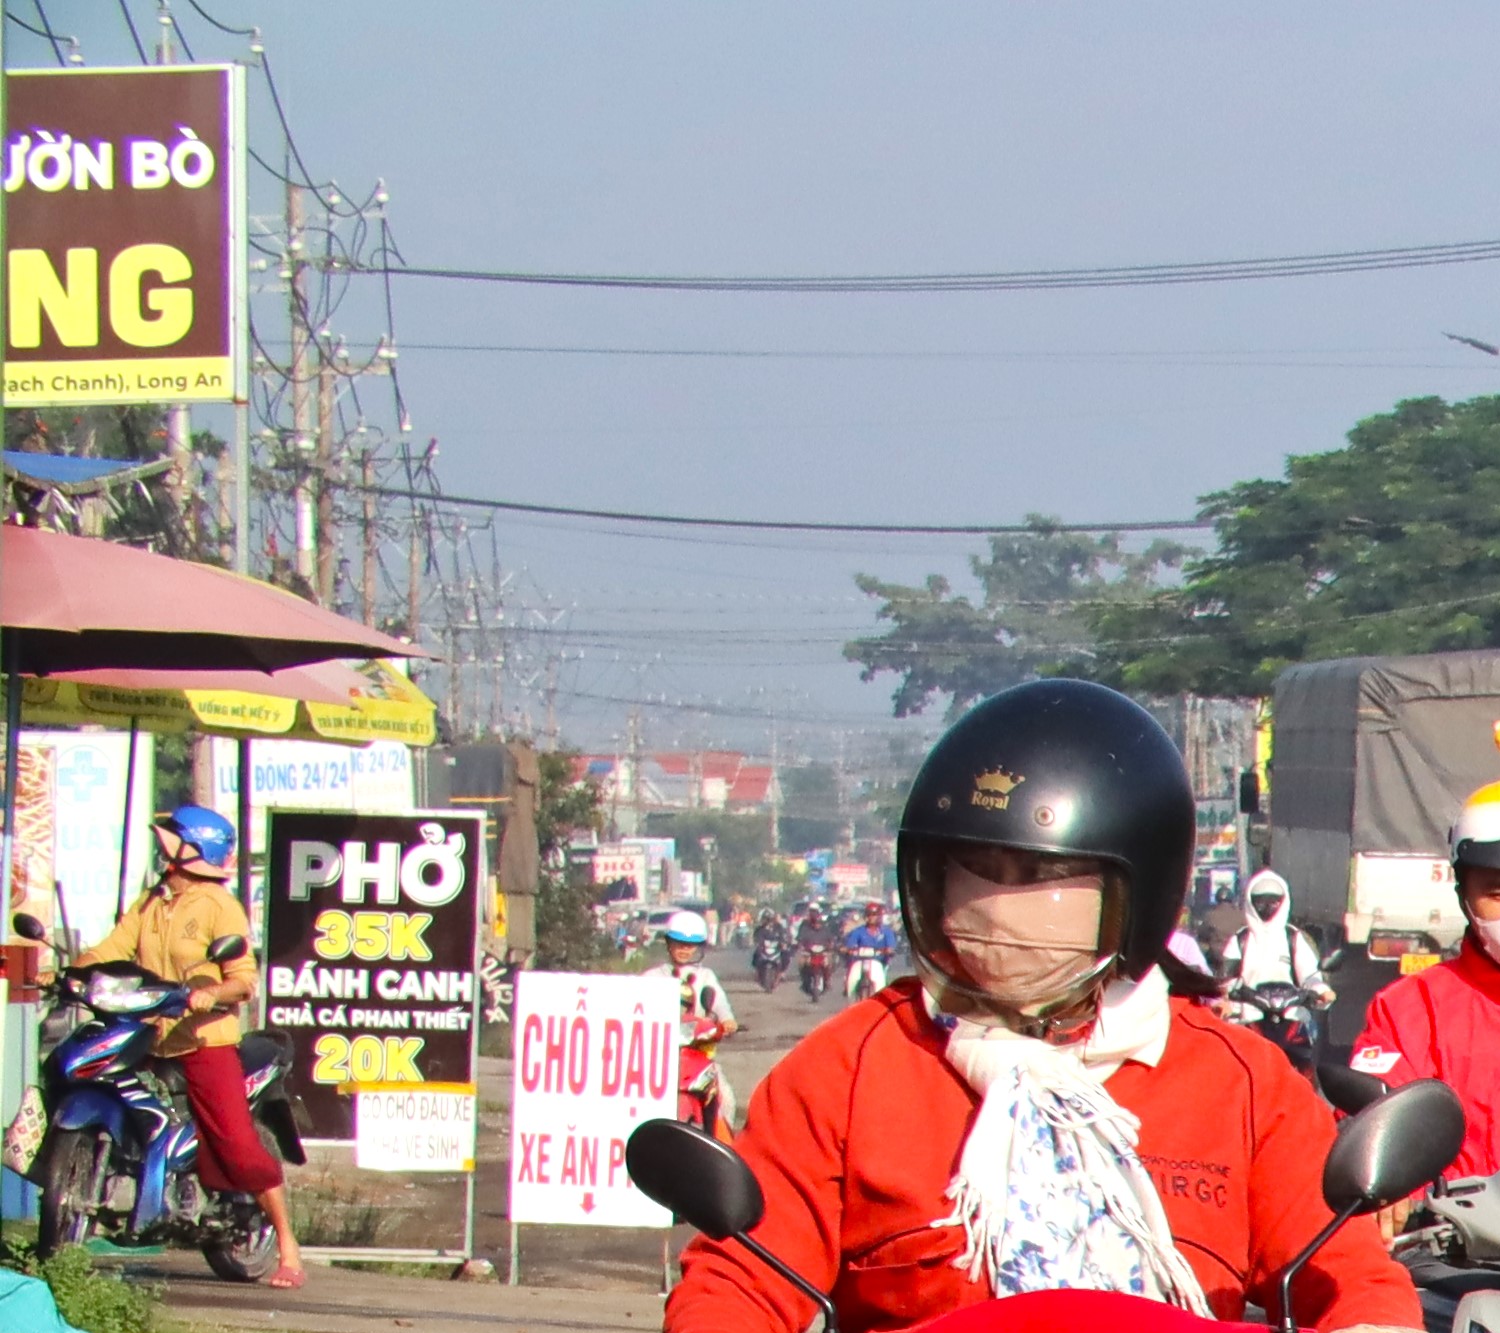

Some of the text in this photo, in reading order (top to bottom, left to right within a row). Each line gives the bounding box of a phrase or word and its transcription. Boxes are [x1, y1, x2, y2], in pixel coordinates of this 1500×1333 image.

[132, 127, 215, 189] BÒ
[9, 243, 195, 348] NG
[51, 373, 130, 393] Chanh),
[138, 373, 188, 391] Long
[195, 372, 222, 388] An
[302, 760, 349, 791] 24/24
[369, 748, 407, 772] 24/24
[971, 791, 1009, 811] Royal
[290, 822, 466, 906] PHỞ
[314, 909, 433, 962] 35K
[270, 961, 370, 1000] BÁNH
[376, 968, 473, 1002] CANH
[271, 1003, 471, 1031] CHÀ CÁ PHAN THIẾT
[313, 1034, 425, 1084] 20K
[521, 987, 590, 1096] CHỖ
[601, 1002, 672, 1117] ĐẬU
[454, 1096, 472, 1121] XE
[427, 1135, 460, 1160] SINH
[518, 1132, 552, 1184] XE
[561, 1124, 599, 1187] ĂN
